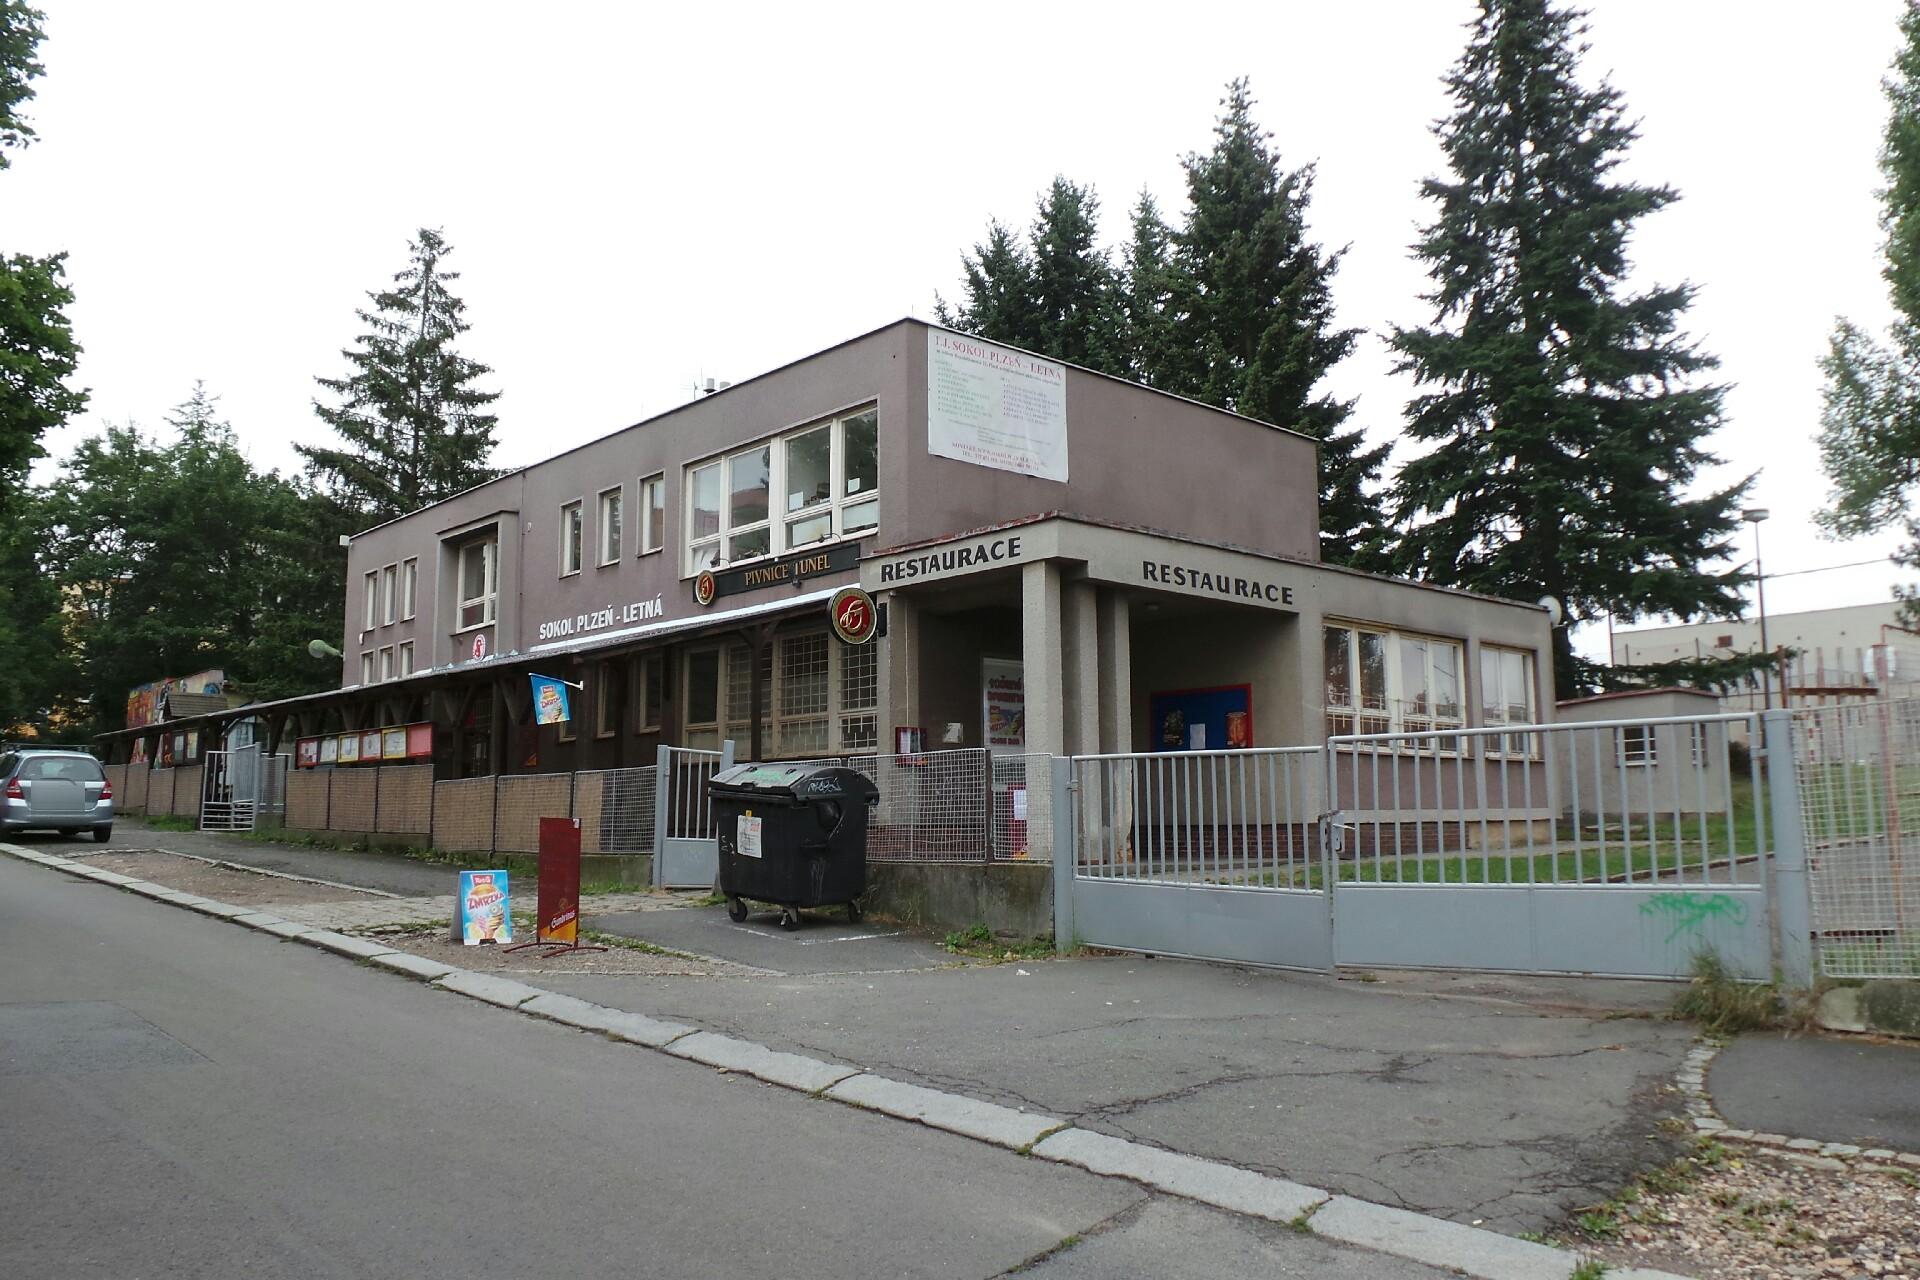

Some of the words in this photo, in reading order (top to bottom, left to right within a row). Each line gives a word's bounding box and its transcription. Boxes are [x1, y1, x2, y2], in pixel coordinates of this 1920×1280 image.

[952, 340, 986, 359] SOKOL
[990, 351, 1021, 369] PLZEŇ
[1030, 362, 1061, 380] LETNÁ
[745, 563, 789, 586] PIVNICE
[793, 554, 831, 576] TUNEL
[881, 536, 1021, 583] RESTAURACE
[1142, 560, 1294, 606] RESTAURACE
[539, 618, 575, 640] SOKOL
[576, 604, 614, 632] PLZEŇ
[623, 593, 663, 623] LETNÁ
